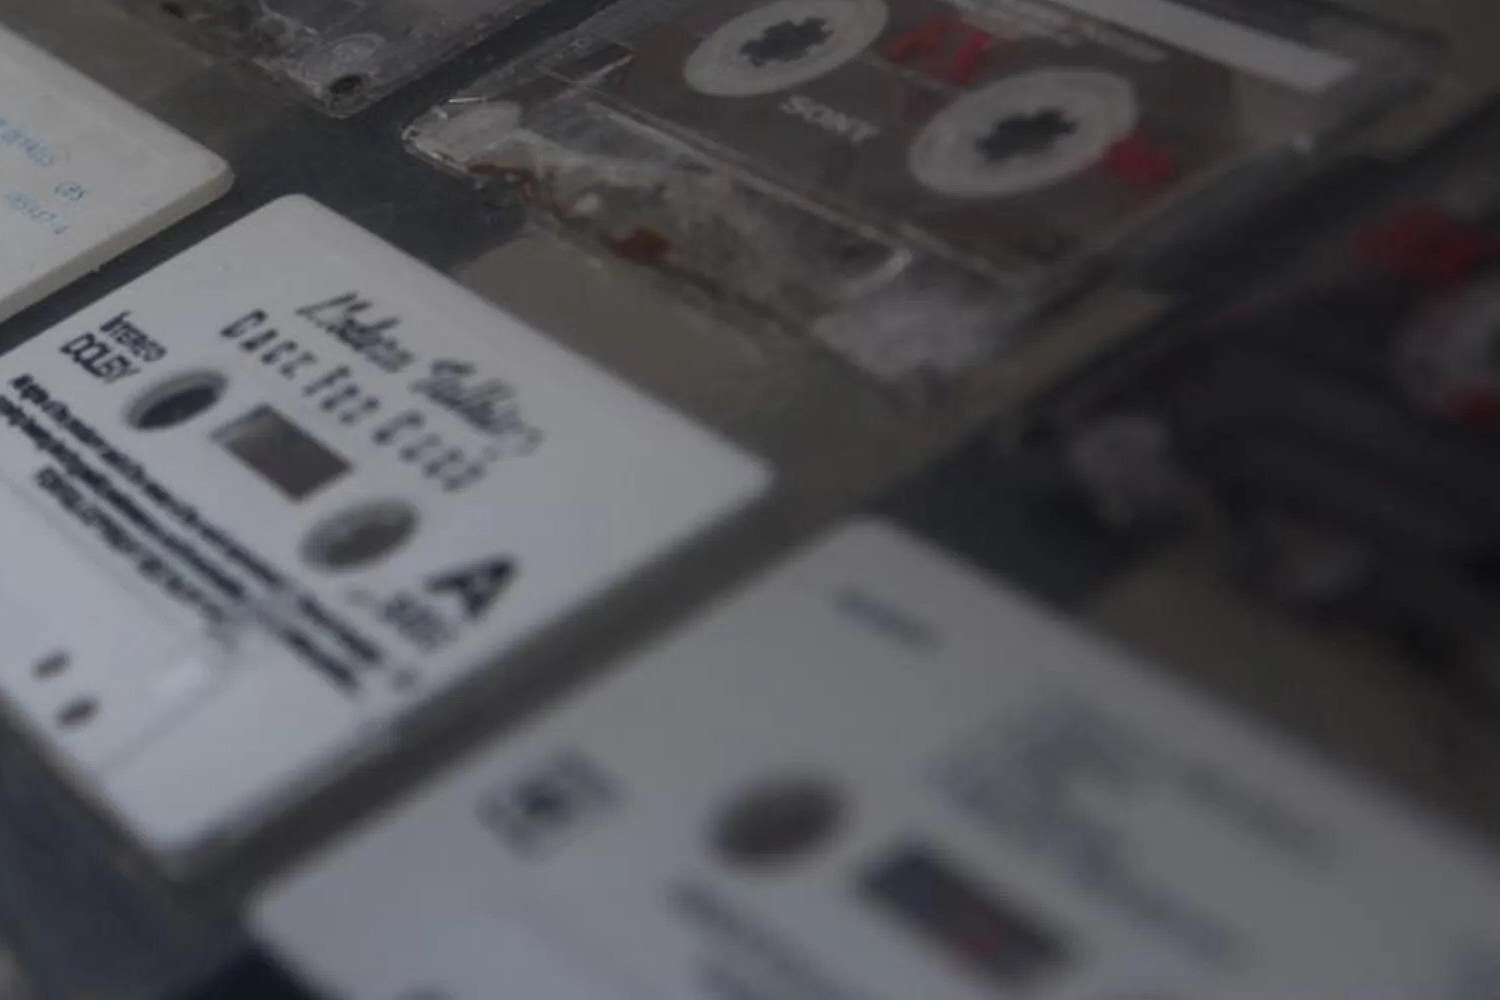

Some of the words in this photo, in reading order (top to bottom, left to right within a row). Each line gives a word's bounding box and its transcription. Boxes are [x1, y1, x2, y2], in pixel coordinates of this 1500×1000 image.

[778, 94, 881, 146] SONY
[58, 332, 142, 384] DOLBY
[423, 555, 517, 624] A
